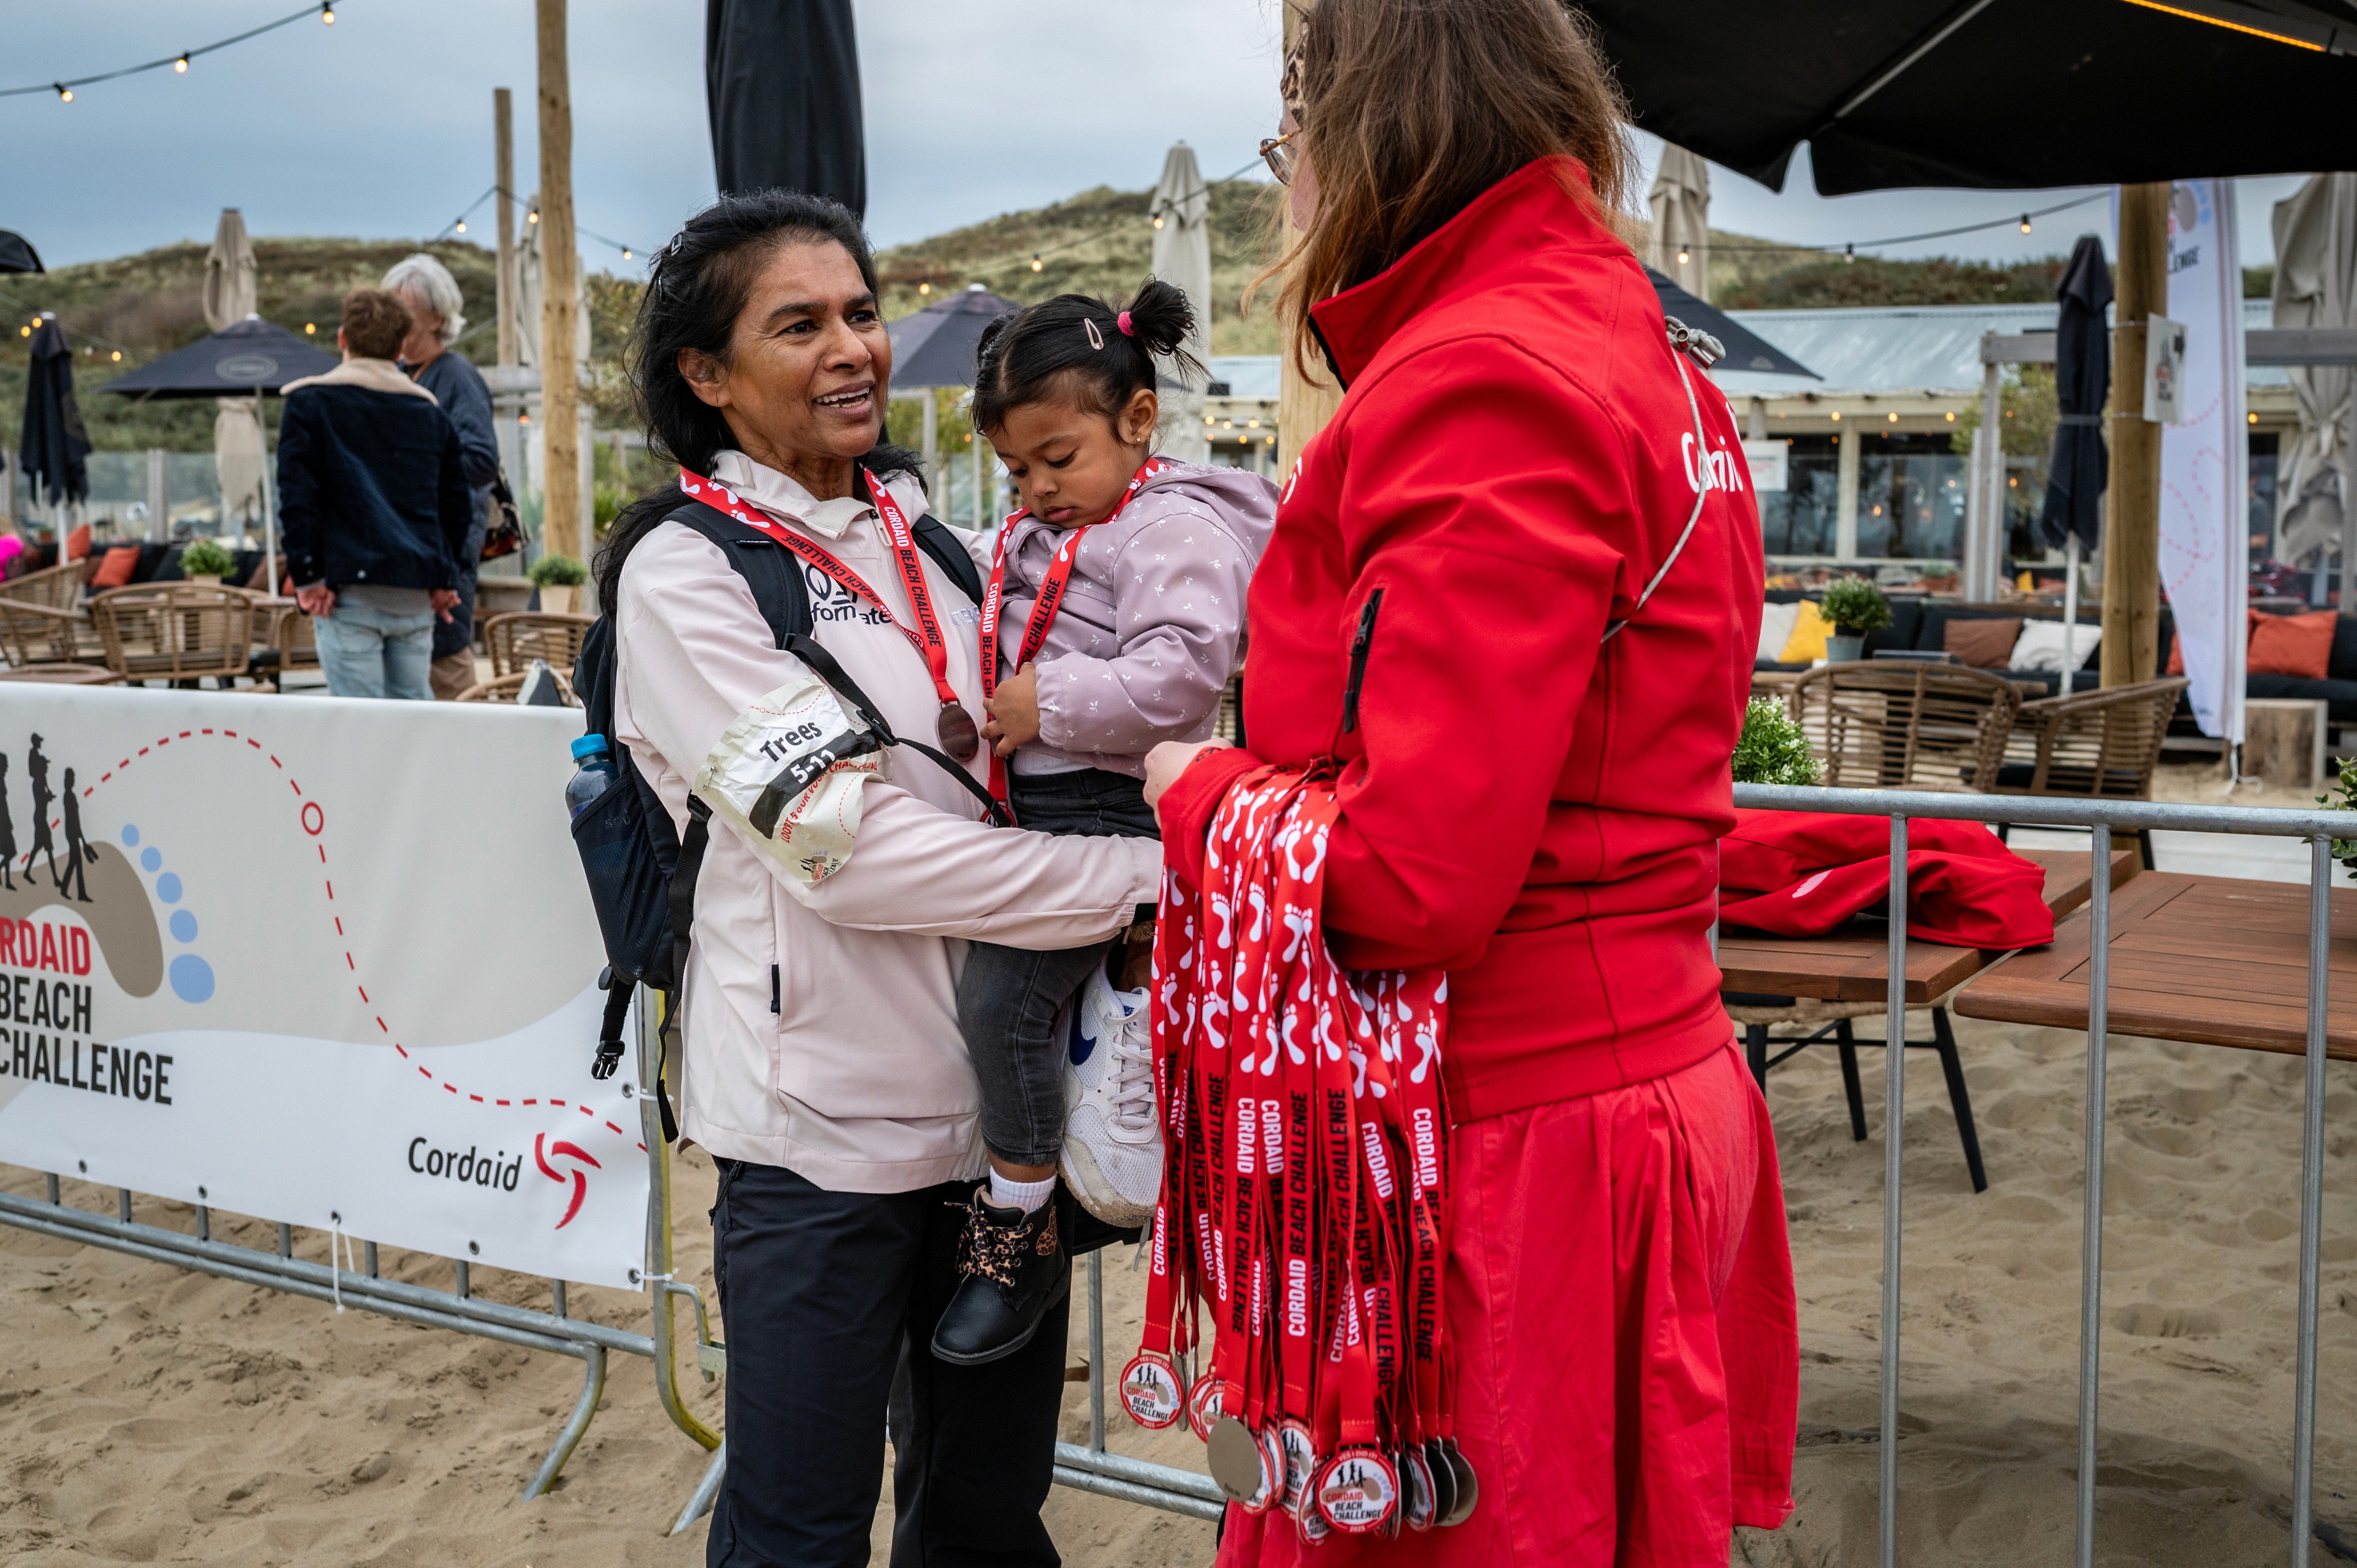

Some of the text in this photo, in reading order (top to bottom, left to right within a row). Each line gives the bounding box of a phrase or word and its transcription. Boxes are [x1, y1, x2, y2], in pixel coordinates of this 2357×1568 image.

[781, 534, 846, 576] CHALLENGE
[884, 507, 941, 647] CORDAID BEACH CHALLENGE
[843, 575, 880, 604] BEACH
[983, 583, 999, 633] CORDAID
[1028, 577, 1061, 646] CHALLENGE
[982, 636, 992, 675] BEACH
[759, 722, 822, 762] Trees
[790, 749, 836, 784] 5-11
[781, 817, 794, 843] LOOPT
[0, 973, 91, 1034] BEACH
[0, 1027, 173, 1105] CHALLENGE
[409, 1137, 522, 1192] Cordaid
[1261, 1100, 1284, 1174] CORDAID
[1328, 1088, 1350, 1192] CHALLENGE
[1361, 1122, 1394, 1198] CORDAID
[1413, 1108, 1438, 1186] CORDAID
[1192, 1159, 1208, 1209] BEACH
[1208, 1072, 1227, 1302] CORDAID BEACH CHALLENGE
[1154, 1206, 1165, 1276] CORDAID
[1233, 1097, 1256, 1337] CORDAID BEACH CHALLENGE
[1288, 1090, 1308, 1337] CORDAID BEACH CHALLENGE
[1414, 1205, 1435, 1261] BEACH
[1355, 1229, 1376, 1285] BEACH
[1251, 1260, 1261, 1337] CORDAID
[1415, 1266, 1435, 1364] CHALLENGE
[1376, 1287, 1395, 1389] CHALLENGE
[1127, 1386, 1156, 1400] CORDAID
[1131, 1404, 1170, 1421] CHALLENGE
[1133, 1397, 1155, 1409] BEACH
[1142, 1420, 1155, 1428] 2025
[1326, 1492, 1363, 1502] CORDAID
[1334, 1510, 1382, 1521] CHALLENGE
[1335, 1502, 1362, 1511] BEACH
